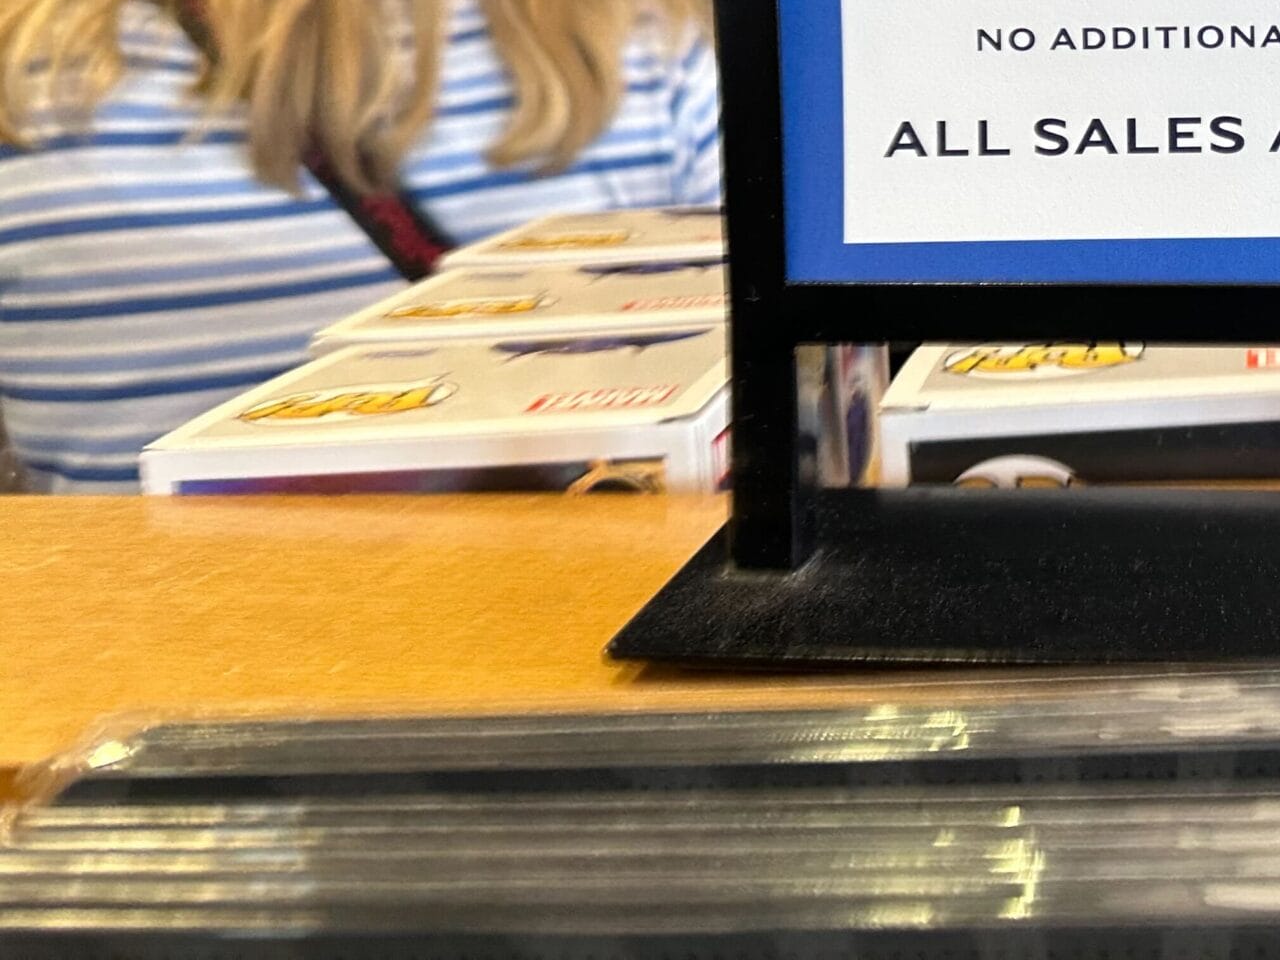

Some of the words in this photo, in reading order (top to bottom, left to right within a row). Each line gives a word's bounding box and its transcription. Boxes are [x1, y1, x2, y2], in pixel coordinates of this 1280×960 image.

[977, 27, 1036, 52] NO
[885, 119, 1011, 158] ALL
[1034, 116, 1245, 156] SALES
